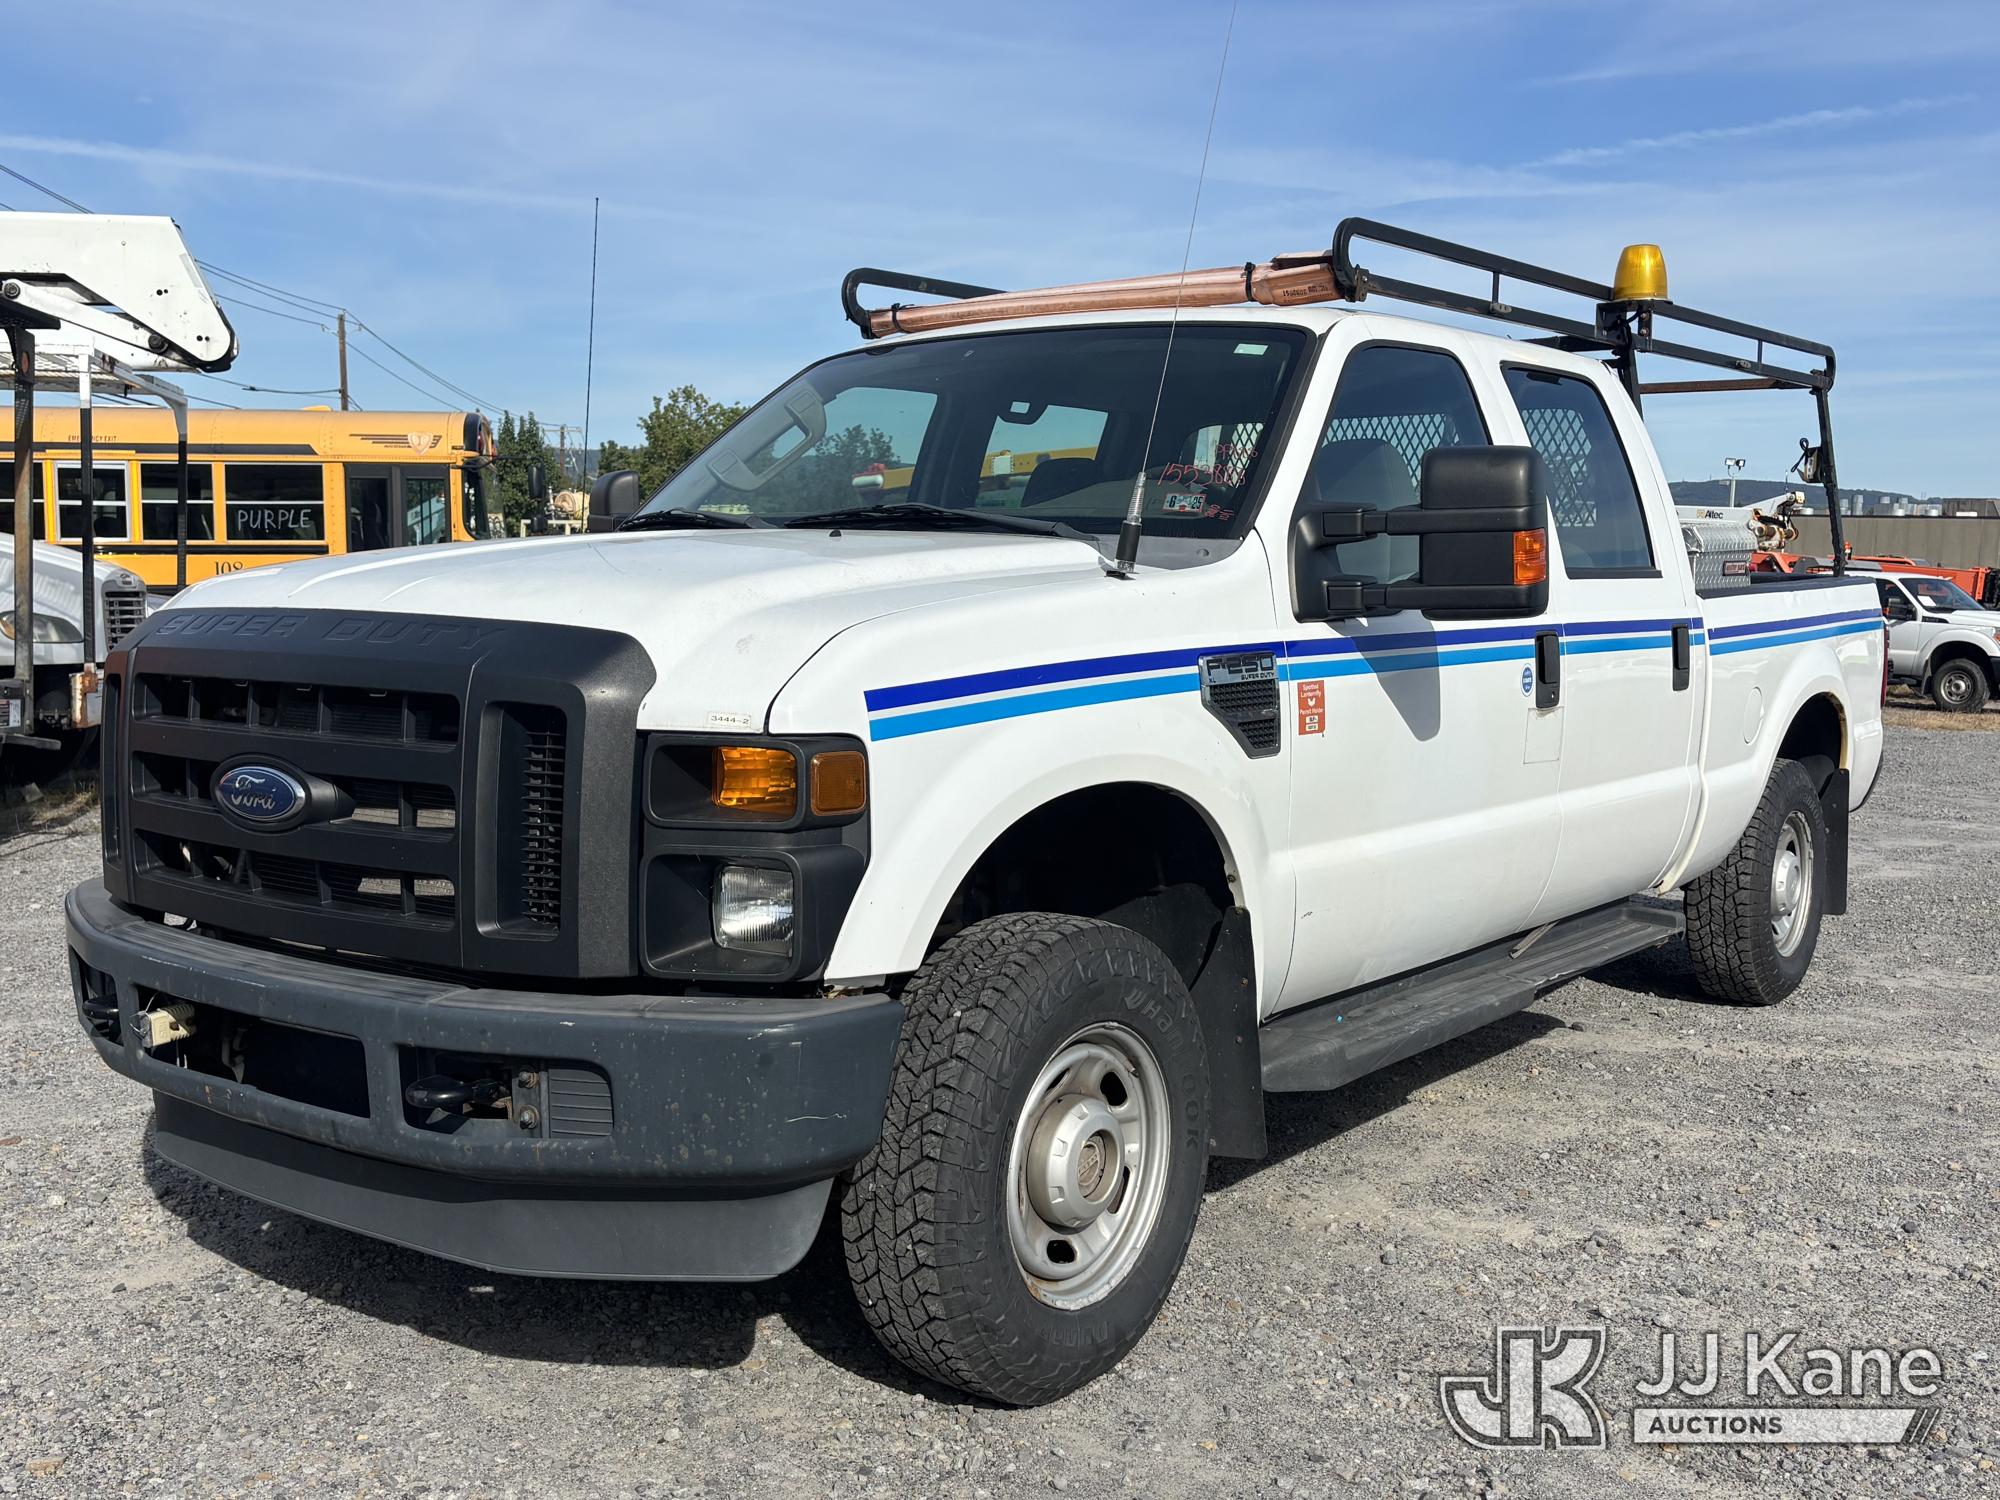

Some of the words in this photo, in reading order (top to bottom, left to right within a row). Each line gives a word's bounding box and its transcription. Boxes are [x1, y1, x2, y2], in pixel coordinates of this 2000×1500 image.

[1168, 495, 1177, 508] 6
[1191, 497, 1204, 509] 25
[238, 508, 312, 532] PURPLE
[1704, 509, 1724, 519] Altec
[156, 614, 309, 638] SUPER
[322, 617, 505, 650] DUTY
[710, 715, 750, 725] 3444-2
[231, 774, 277, 810] Ford
